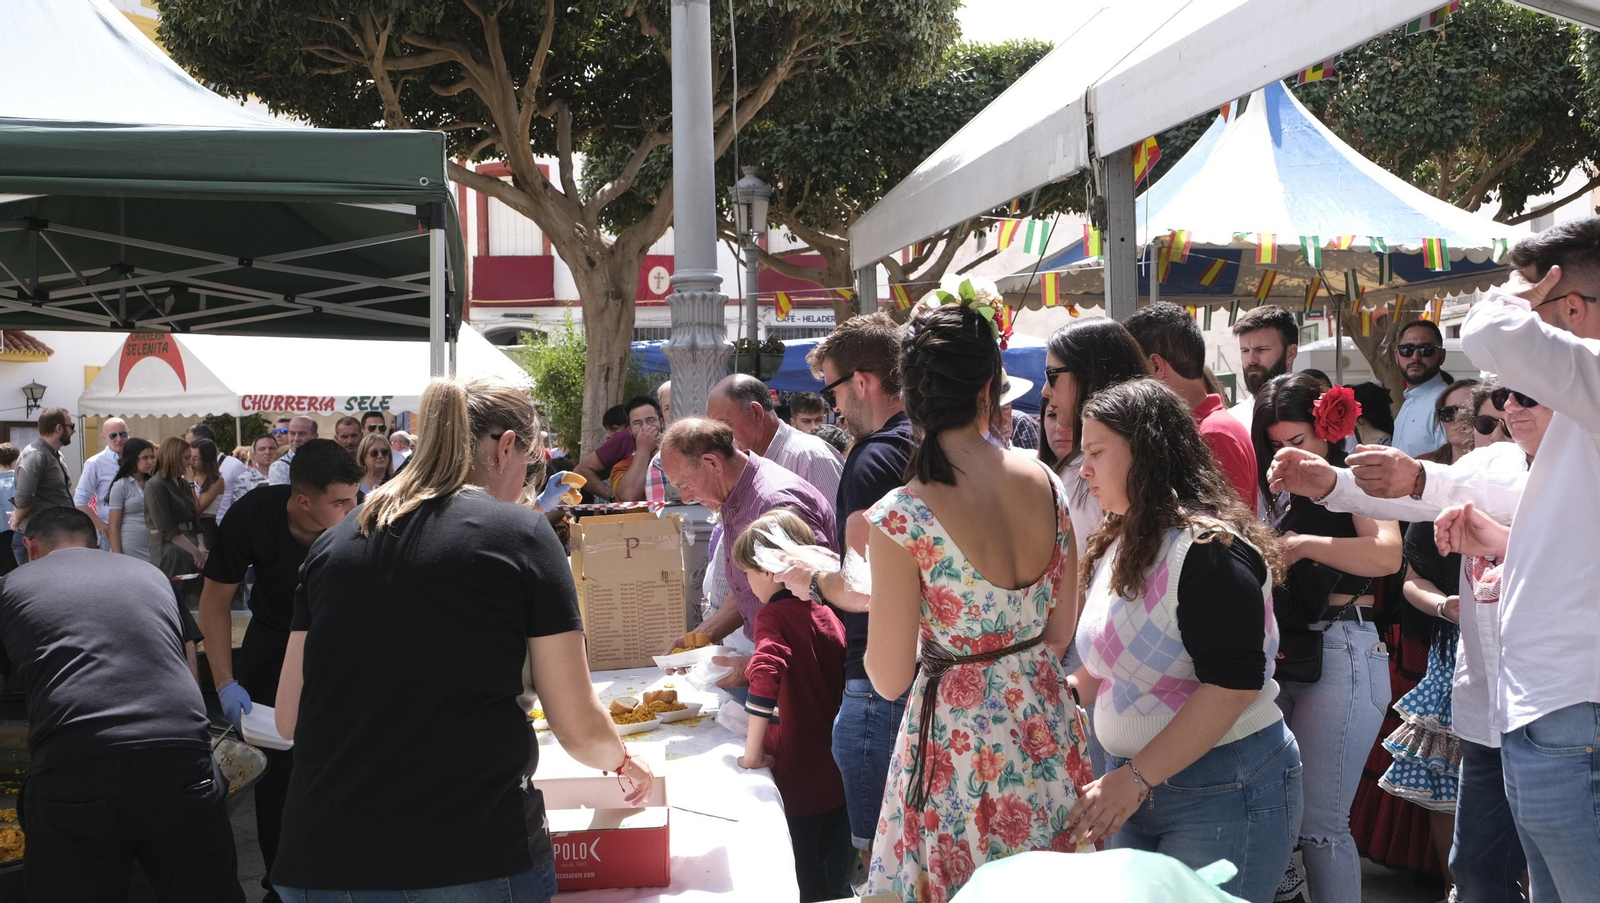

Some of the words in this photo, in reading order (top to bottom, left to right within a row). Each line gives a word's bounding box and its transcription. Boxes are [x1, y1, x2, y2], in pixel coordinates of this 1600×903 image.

[126, 341, 169, 356] SELENITA
[241, 394, 336, 412] CHURRERIA
[344, 395, 394, 412] SELE
[623, 537, 640, 559] P
[553, 842, 587, 861] POLO
